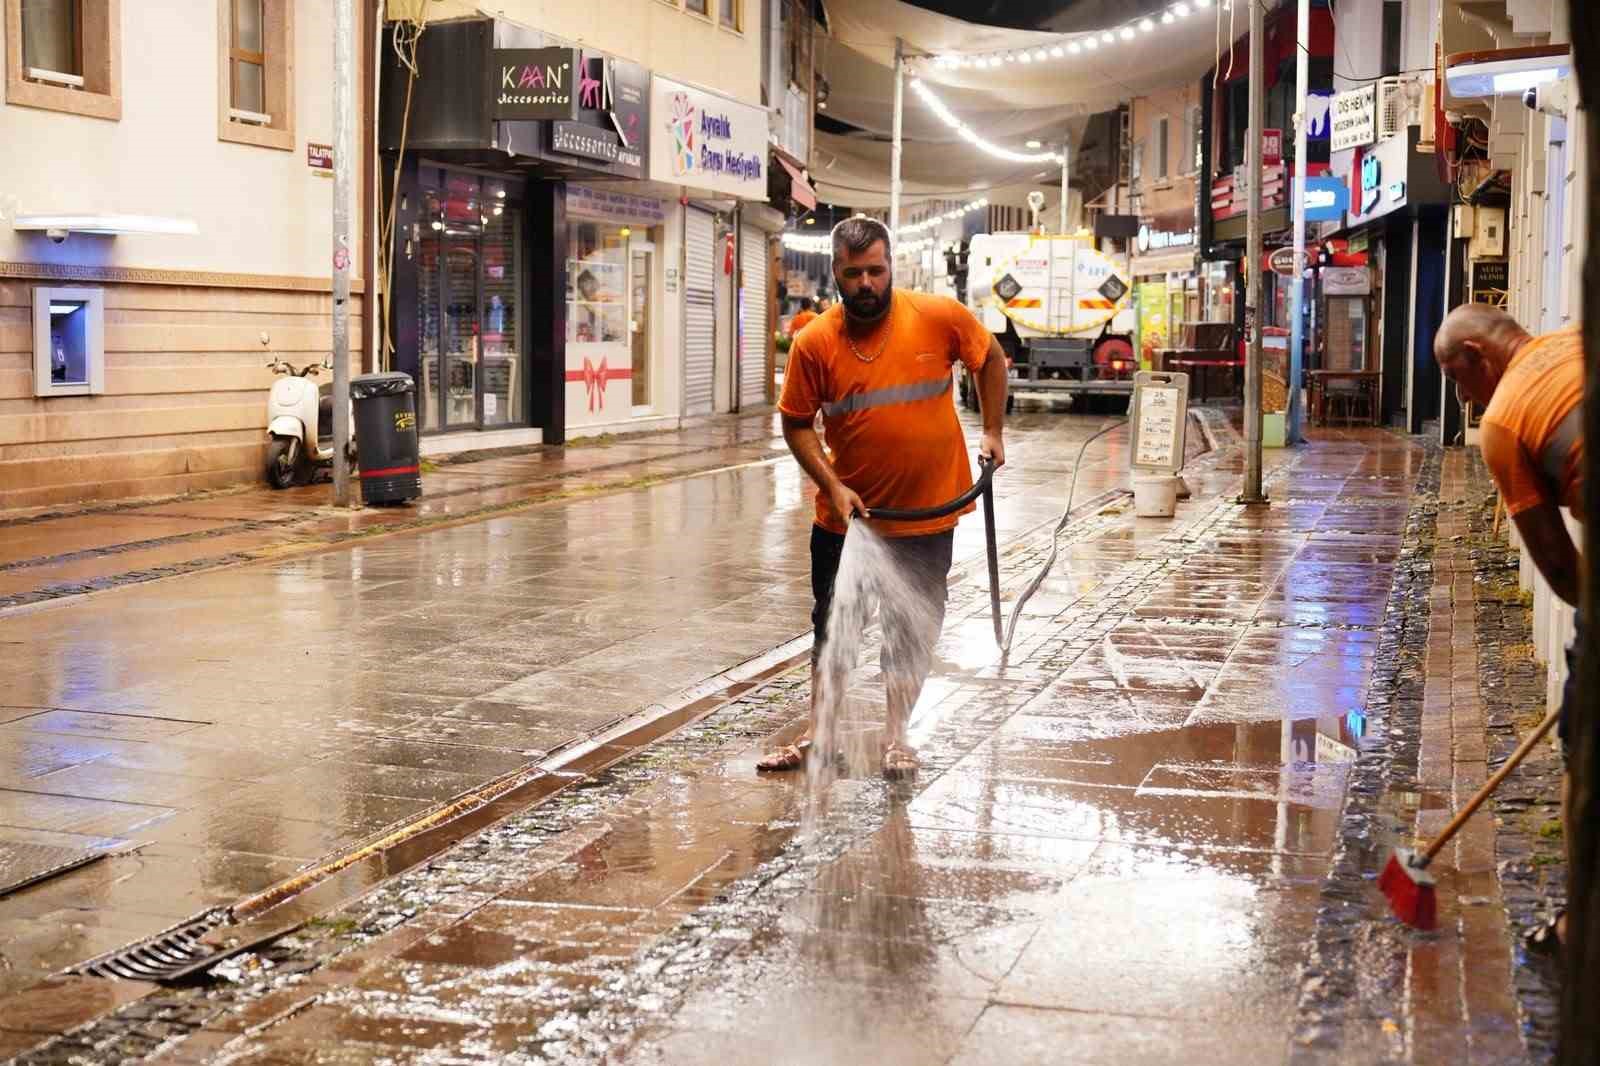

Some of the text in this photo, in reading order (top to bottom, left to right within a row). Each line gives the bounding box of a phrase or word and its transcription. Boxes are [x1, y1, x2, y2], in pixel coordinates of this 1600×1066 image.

[502, 64, 562, 89] KAAN
[497, 92, 569, 105] Accessories
[701, 108, 732, 140] Ayvalık
[554, 125, 617, 158] Accessories
[726, 150, 761, 181] Hediyelik
